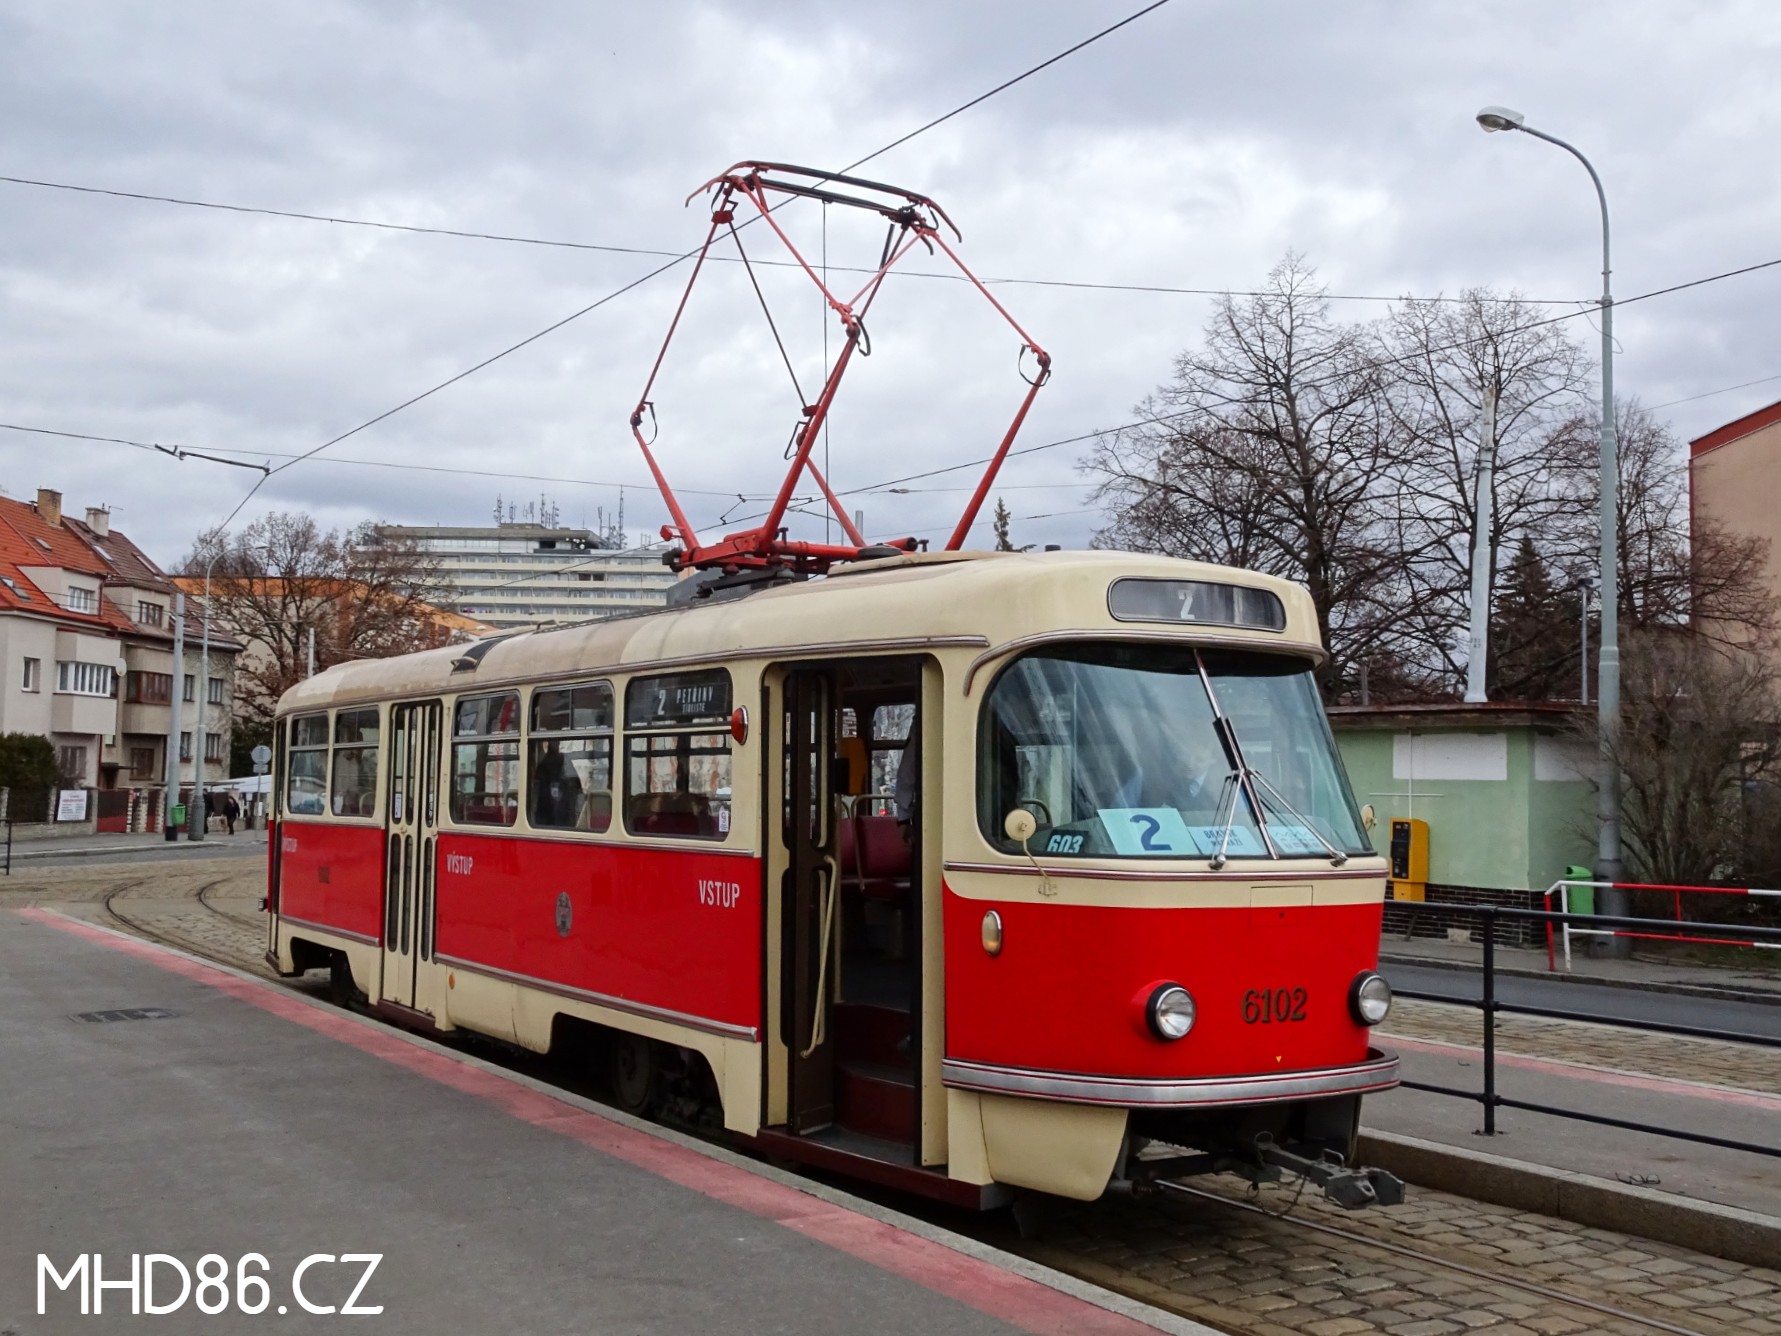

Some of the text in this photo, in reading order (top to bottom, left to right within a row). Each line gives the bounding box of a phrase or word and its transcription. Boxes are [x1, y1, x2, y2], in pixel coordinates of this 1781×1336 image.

[1178, 589, 1196, 620] 2
[657, 689, 667, 716] 2
[1046, 834, 1084, 853] 603
[1130, 814, 1173, 851] 2
[446, 850, 474, 876] VÝSTUP
[698, 879, 740, 909] VSTUP
[1241, 987, 1308, 1024] 6102
